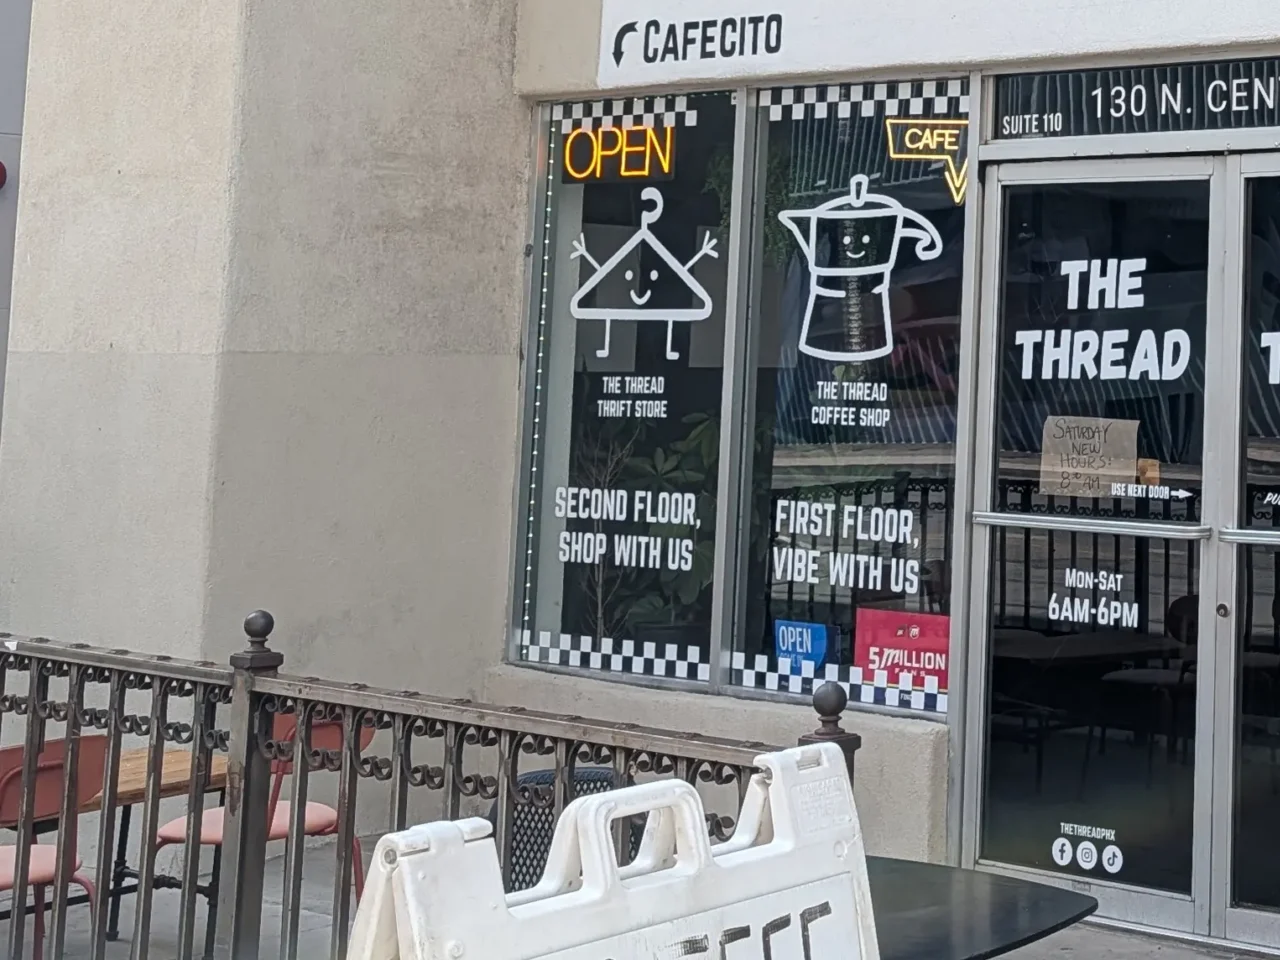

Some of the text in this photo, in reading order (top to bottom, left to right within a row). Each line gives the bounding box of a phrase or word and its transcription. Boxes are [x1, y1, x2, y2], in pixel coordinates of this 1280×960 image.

[642, 12, 783, 64] CAFECITO
[1091, 84, 1147, 119] 130
[1161, 82, 1192, 115] N.
[1003, 112, 1062, 135] SUITE 110
[905, 128, 960, 151] CAFE
[564, 125, 672, 180] OPEN
[1060, 258, 1147, 309] THE
[1015, 329, 1191, 380] THREAD
[602, 376, 665, 394] THE THREAD
[817, 381, 888, 401] THE THREAD
[597, 400, 668, 418] THRIFT STORE
[811, 406, 890, 428] COFFEE SHOP
[1071, 442, 1101, 456] NEW
[1060, 453, 1112, 470] HOURS:
[1083, 475, 1100, 490] AM
[1111, 483, 1170, 499] USE NEXT DOOR
[555, 486, 702, 530] SECOND FLOOR,
[775, 499, 919, 549] FIRST FLOOR,
[559, 531, 693, 571] SHOP WITH US
[772, 546, 919, 595] VIBE WITH US
[1065, 568, 1123, 592] MON-SAT
[1048, 593, 1139, 628] 6AM-6PM
[779, 626, 811, 654] OPEN
[868, 646, 879, 669] 5
[1060, 822, 1116, 841] THETHREADPHX
